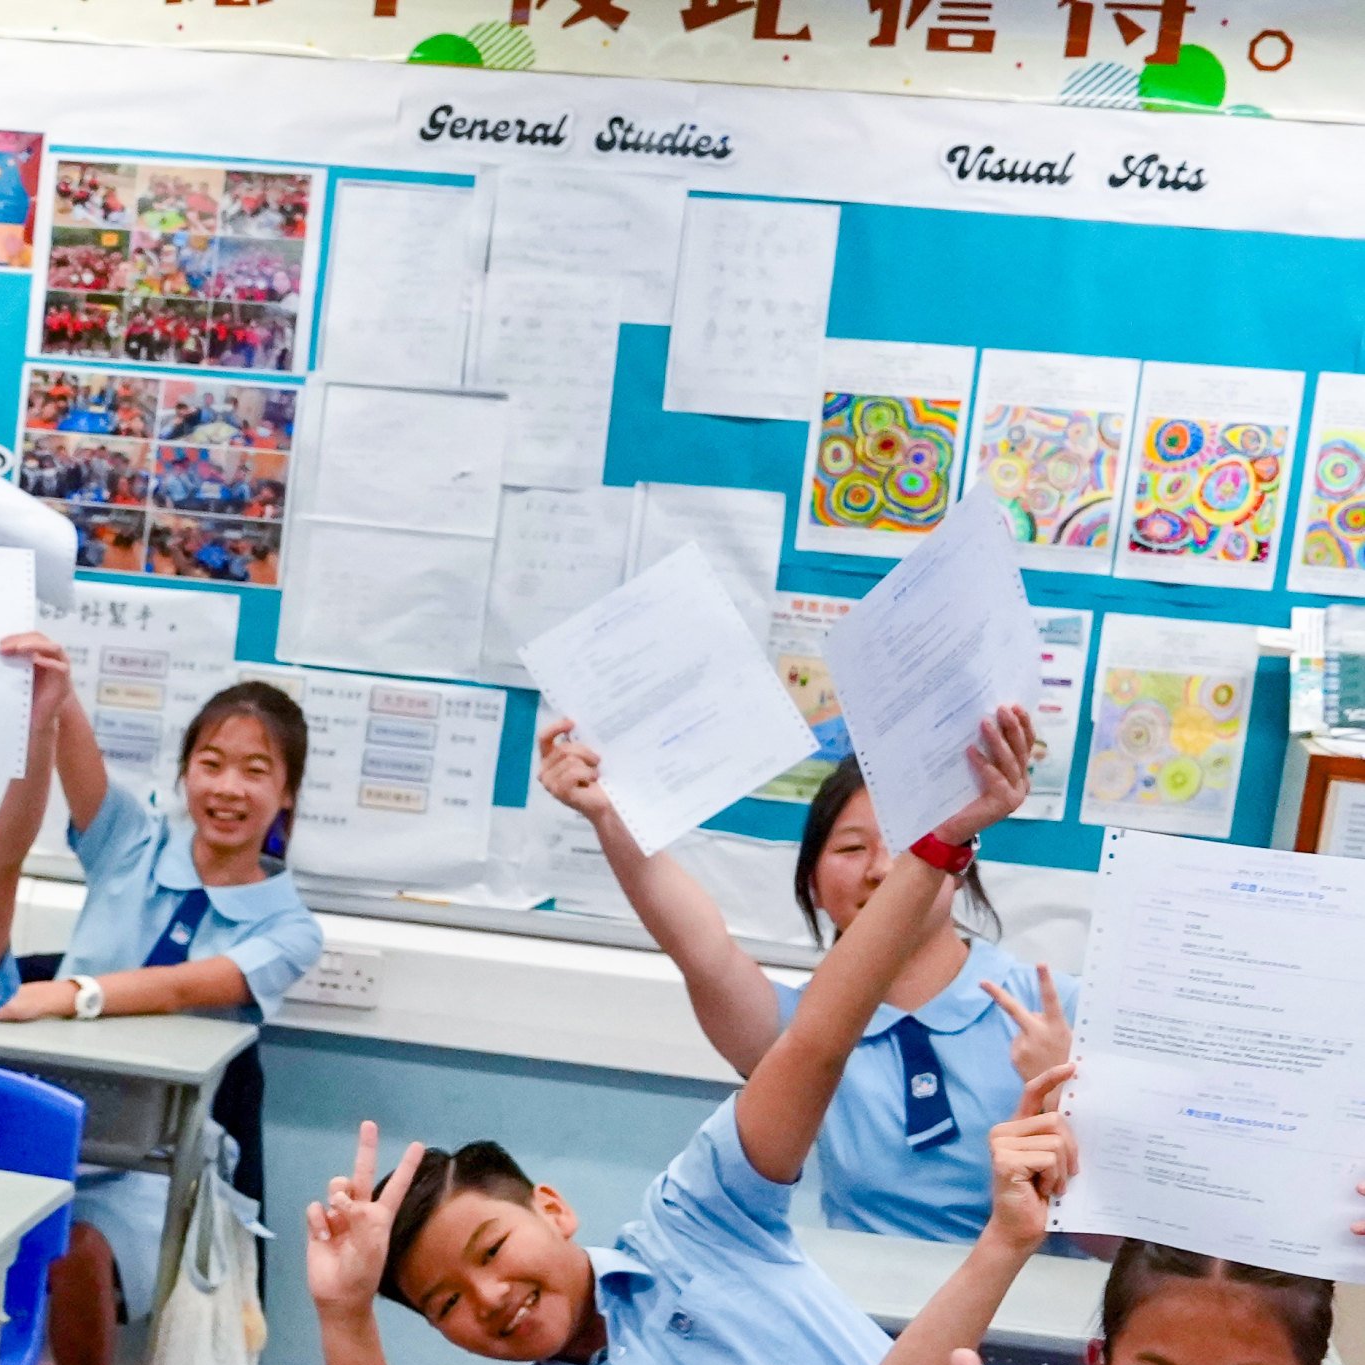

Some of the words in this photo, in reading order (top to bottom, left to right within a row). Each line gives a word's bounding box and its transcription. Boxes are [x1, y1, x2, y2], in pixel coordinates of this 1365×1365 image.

[419, 104, 568, 146] General
[595, 116, 734, 159] Studies
[946, 145, 1075, 185] Visual
[1108, 153, 1208, 191] Arts
